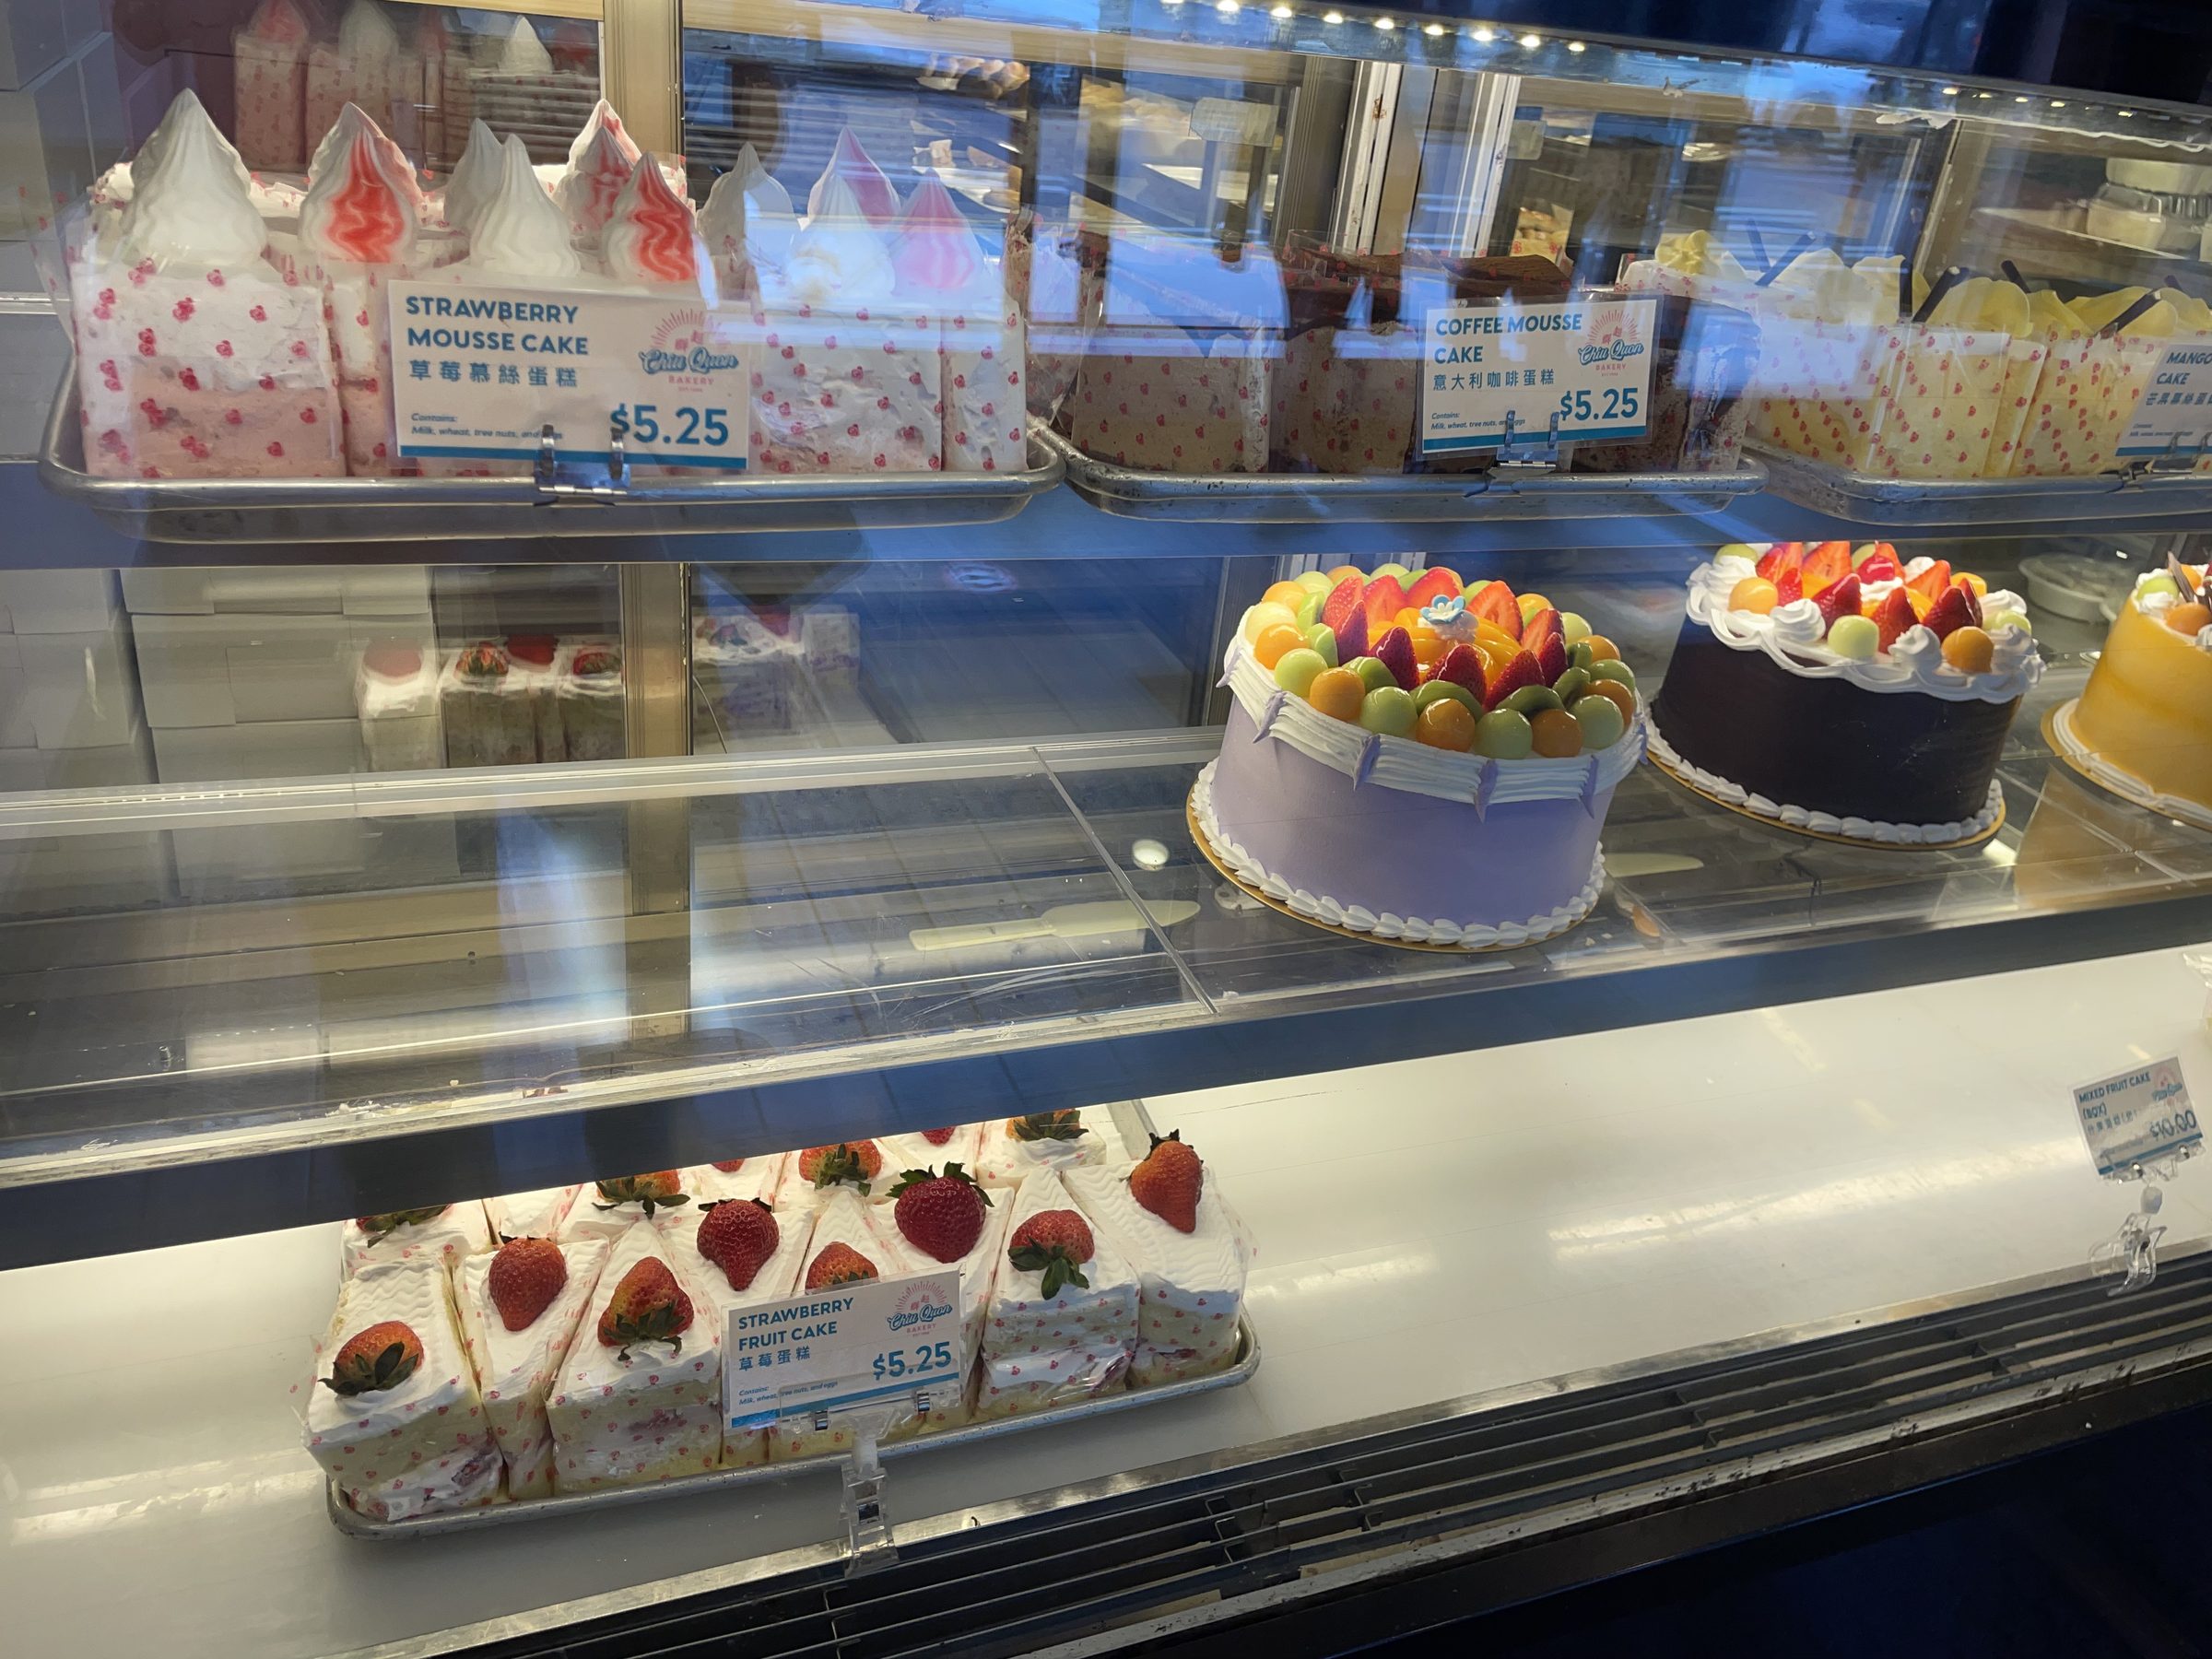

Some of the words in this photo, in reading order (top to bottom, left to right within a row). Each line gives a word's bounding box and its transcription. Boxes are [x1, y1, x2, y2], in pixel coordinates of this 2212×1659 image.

[406, 296, 579, 324] STRAWBERRY
[1436, 316, 1503, 335] COFFEE
[1507, 313, 1583, 333] MOUSSE
[407, 327, 515, 351] MOUSSE
[521, 334, 590, 356] CAKE
[1434, 346, 1483, 364] CAKE
[1578, 344, 1609, 366] Chiu
[1610, 339, 1644, 360] Quon
[668, 375, 714, 385] BAKERY
[1433, 369, 1555, 392] 意大利咖啡蛋糕
[2157, 372, 2190, 384] CAKE
[1560, 387, 1638, 421] $5.25
[610, 403, 729, 446] $5.25
[2079, 1087, 2105, 1103] MIXED
[2106, 1078, 2128, 1094] FRUIT
[2129, 1071, 2151, 1087] CAKE
[2149, 1109, 2197, 1141] $10.00
[738, 1297, 853, 1329] STRAWBERRY
[887, 1312, 919, 1331] Chiu
[919, 1303, 952, 1323] Quon
[739, 1330, 787, 1351] FRUIT
[791, 1321, 838, 1341] CAKE
[907, 1324, 936, 1333] BAKERY
[739, 1346, 810, 1371] 草莓蛋糕
[873, 1341, 951, 1381] $5.25
